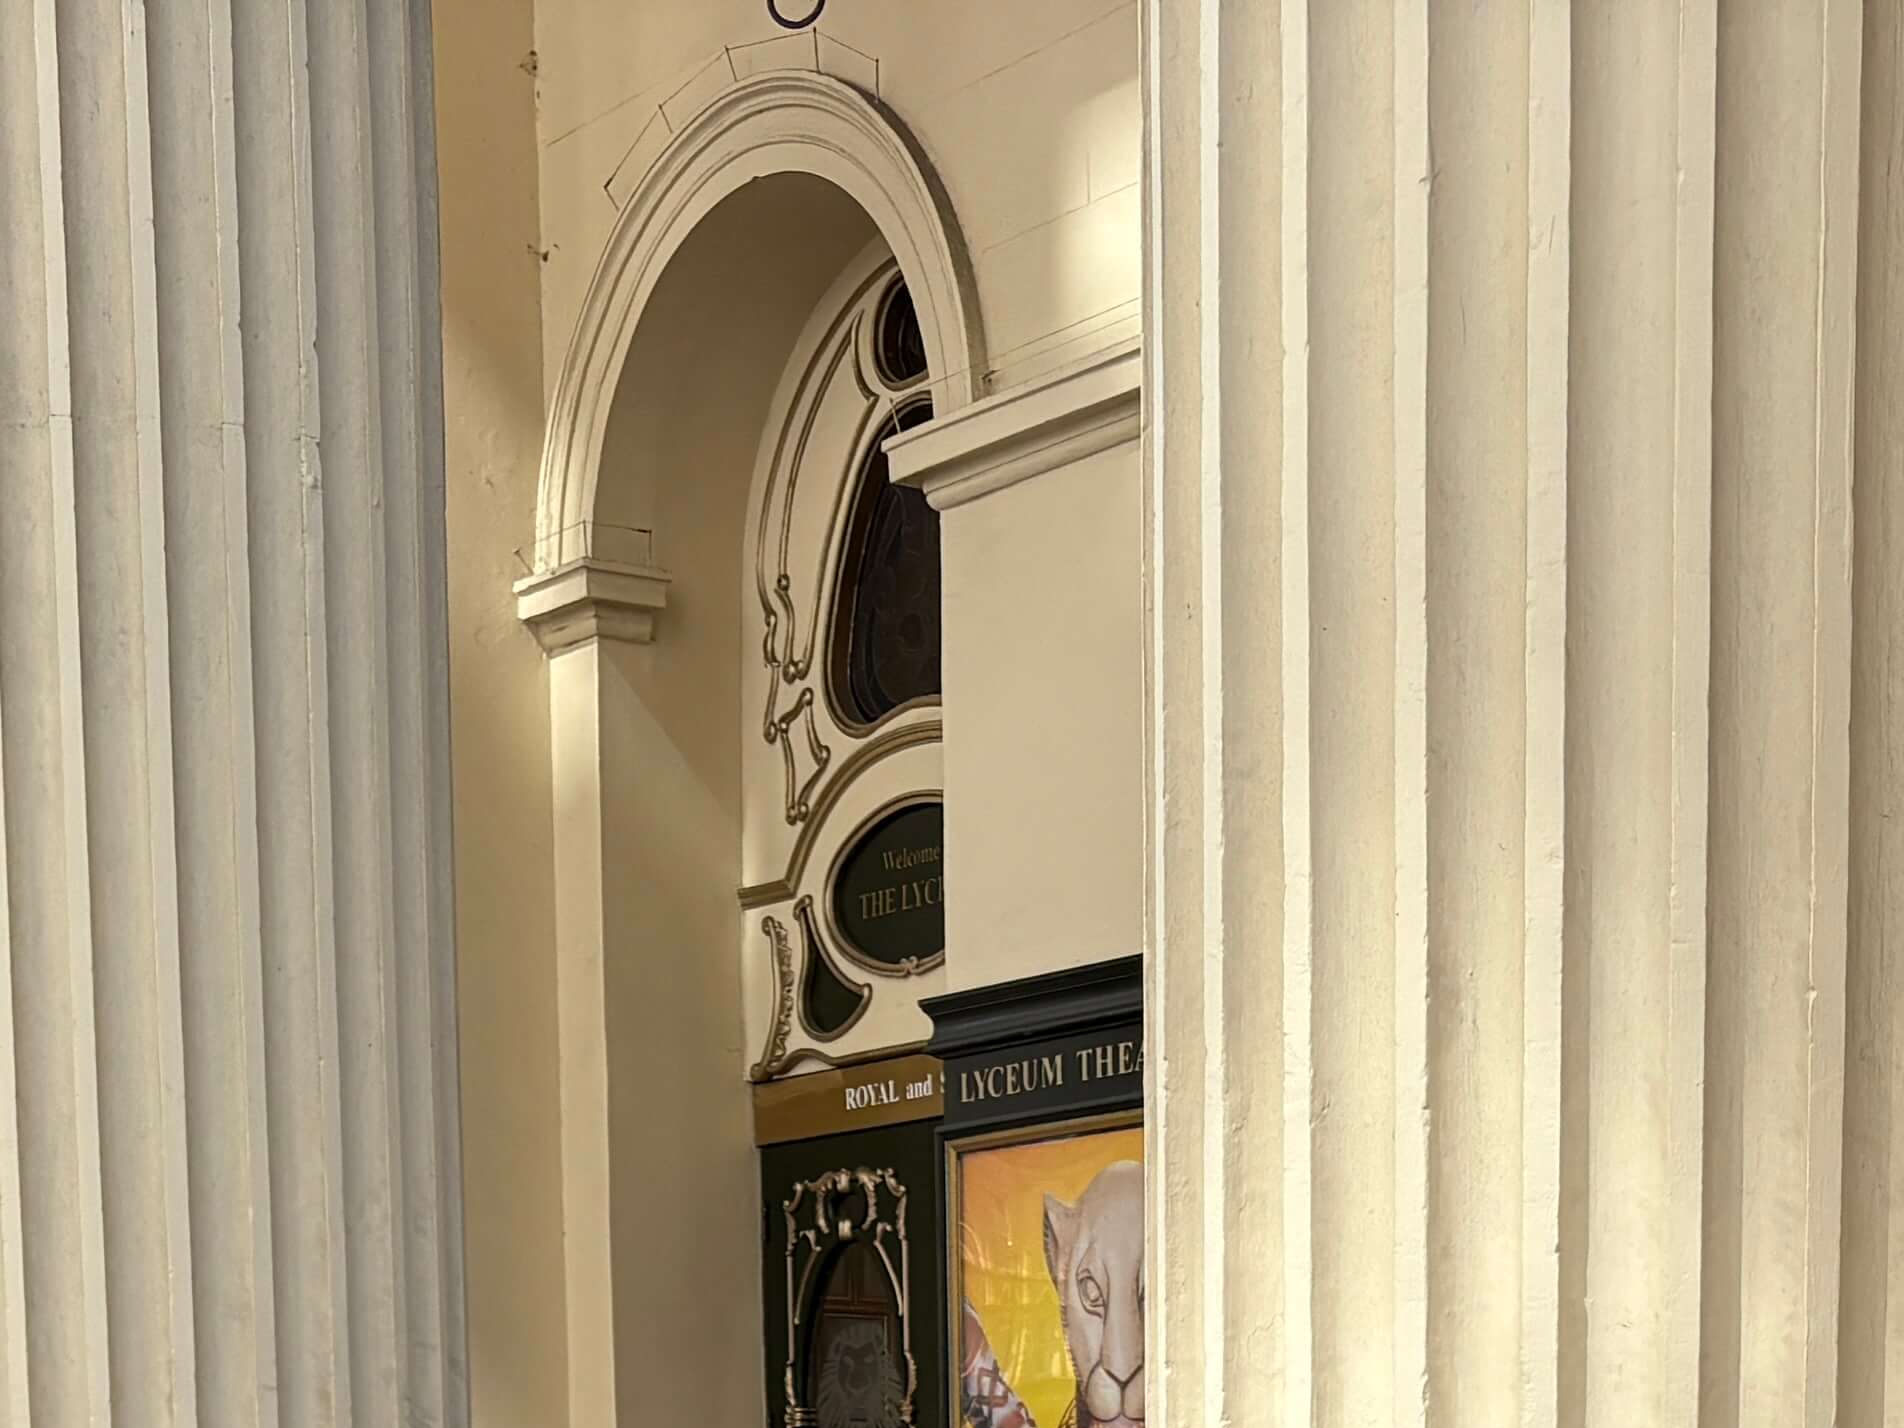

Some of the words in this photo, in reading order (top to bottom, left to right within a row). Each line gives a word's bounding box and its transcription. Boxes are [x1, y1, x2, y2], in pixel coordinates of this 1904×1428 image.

[882, 847, 941, 870] Welcome
[859, 887, 897, 919] THE
[845, 1079, 899, 1111] ROYAL
[905, 1073, 933, 1100] and
[960, 1054, 1064, 1103] LYCEUM
